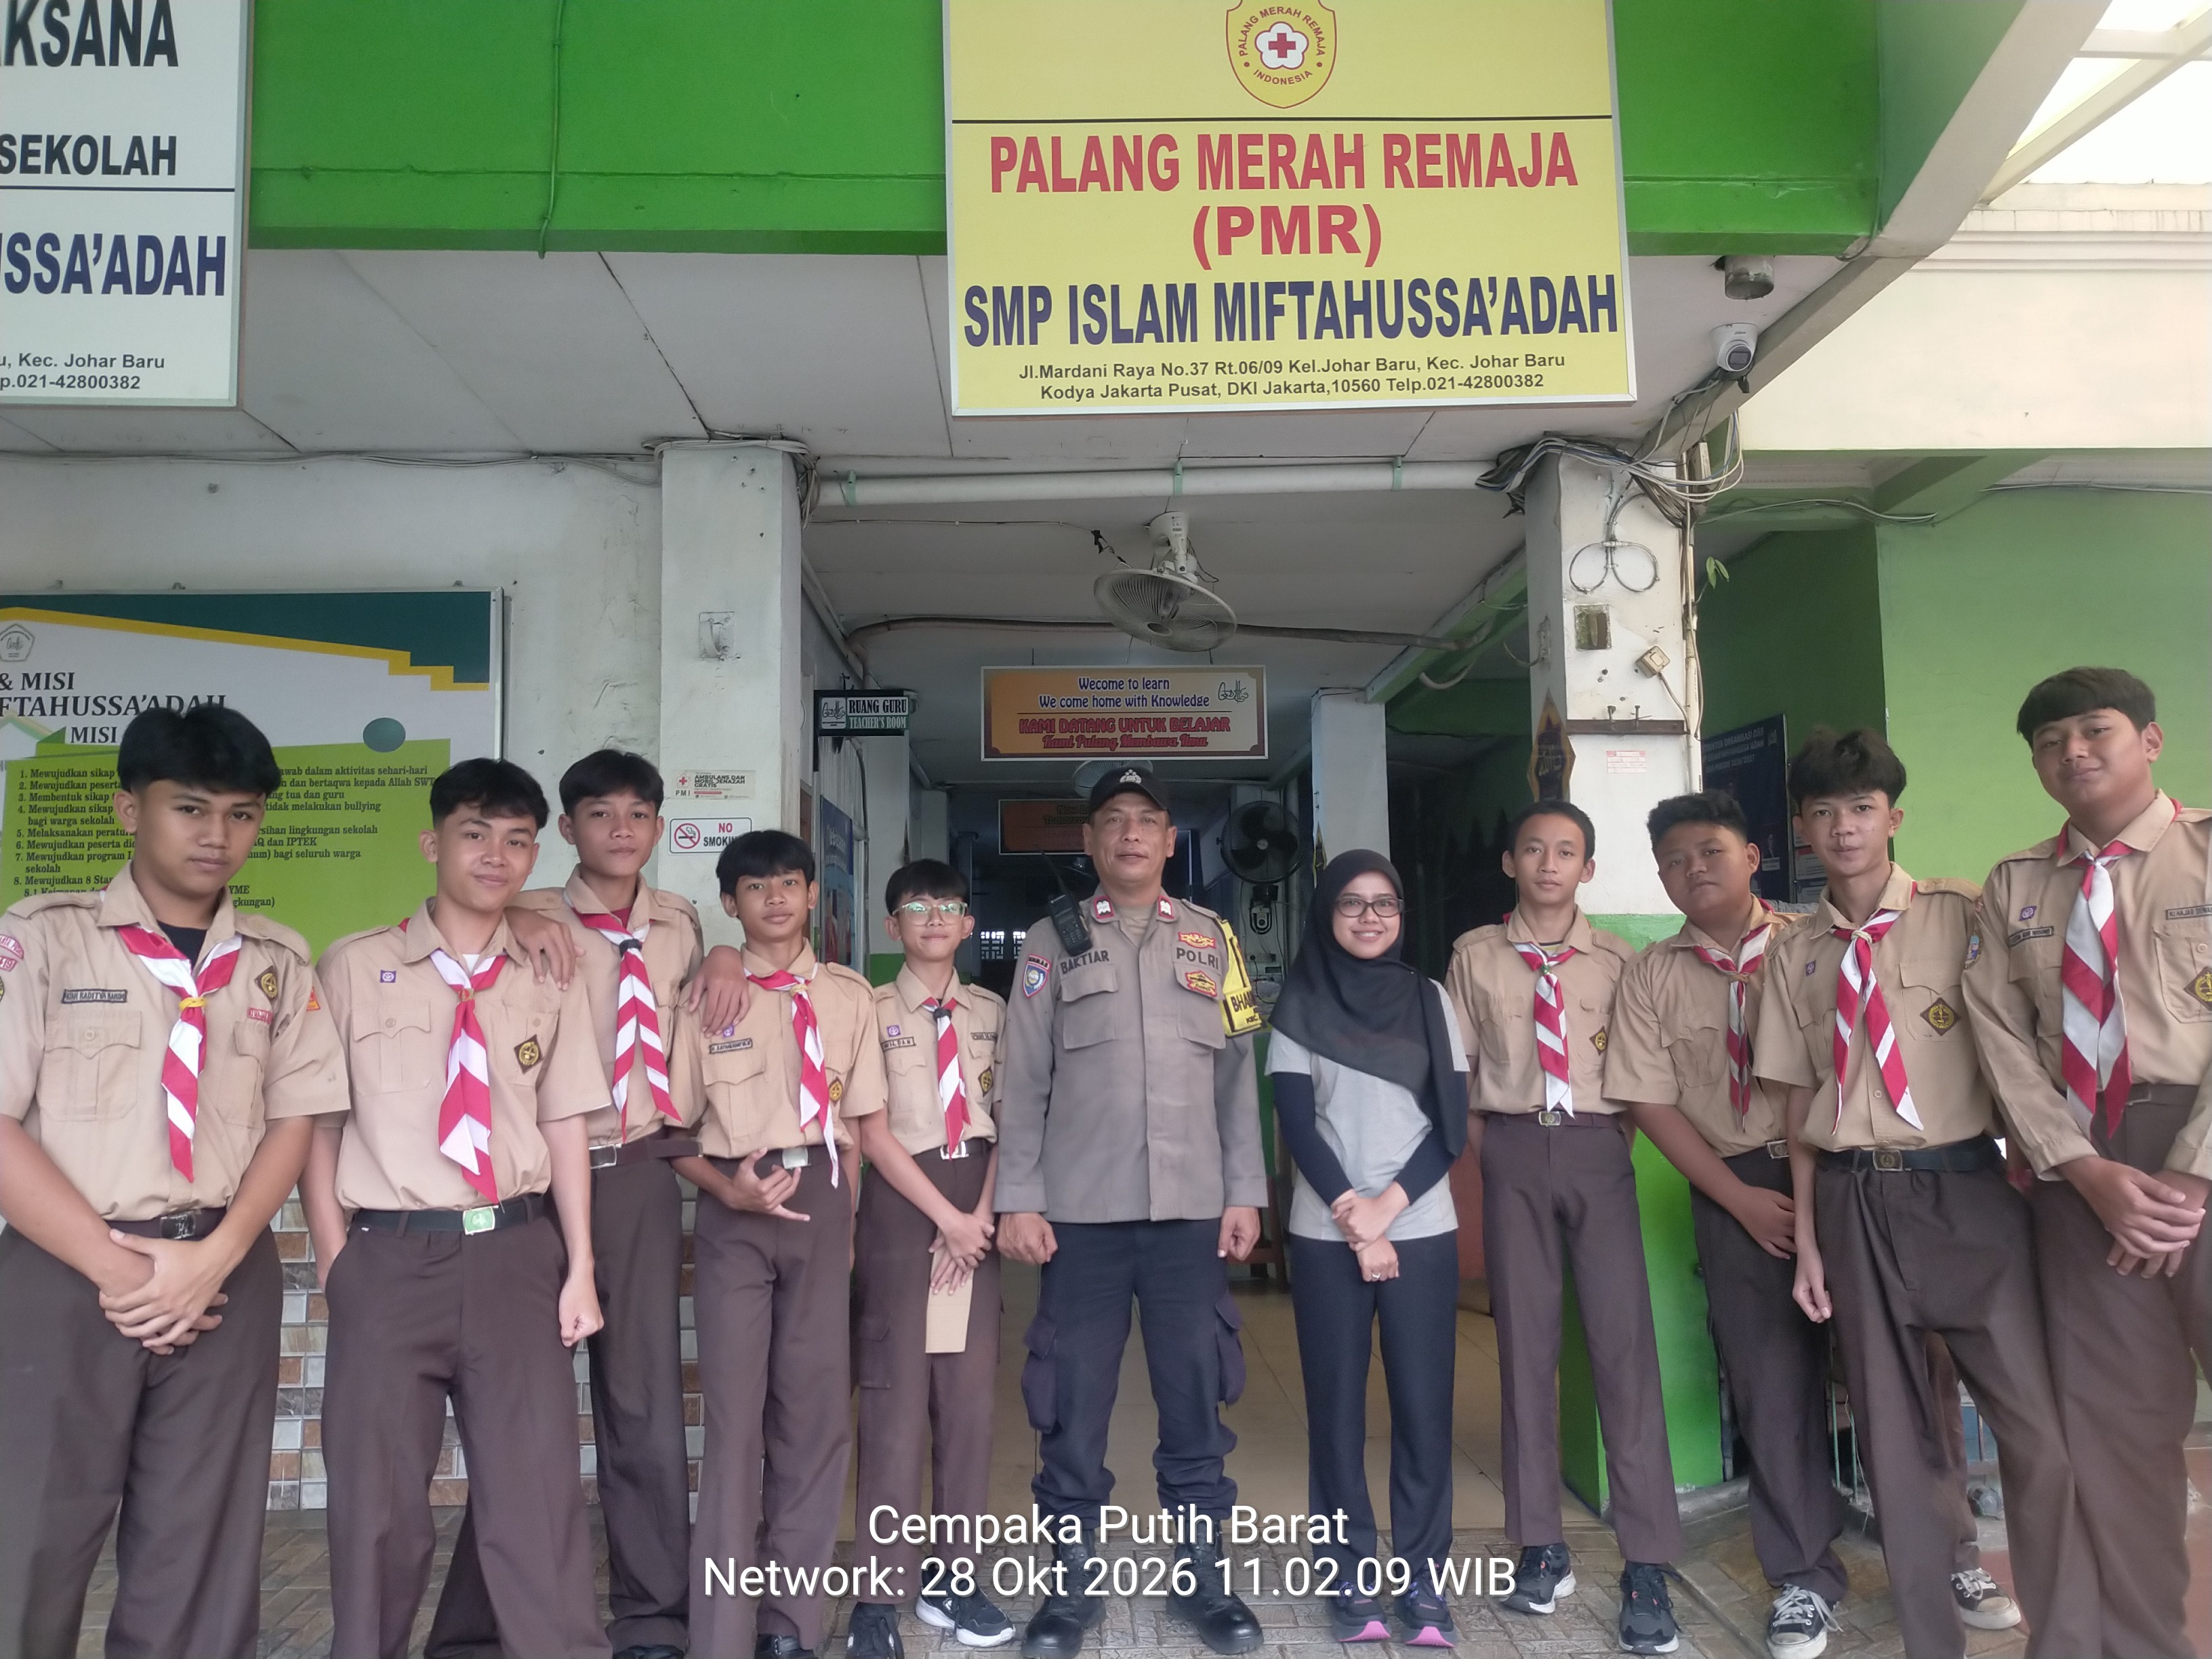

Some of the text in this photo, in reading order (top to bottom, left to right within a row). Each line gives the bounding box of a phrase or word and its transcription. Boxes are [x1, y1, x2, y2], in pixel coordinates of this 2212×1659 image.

[1238, 7, 1326, 56] PALANG MERAH REMAJA
[1253, 69, 1313, 85] INDONESIA
[0, 134, 177, 176] SEKOLAH
[991, 132, 1578, 192] PALANG MERAH REMAJA
[1193, 204, 1381, 270] (PMR)
[0, 232, 226, 295] SSA'ADAH
[964, 274, 1618, 347] SMP ISLAM MIFTAHUSSA'ADAH
[18, 353, 58, 367] Kec.
[64, 354, 117, 367] Johar
[123, 354, 165, 368] Baru
[1019, 354, 1565, 380] Jl.Mardani Raya No.37 Rt.06/09 Kel.Johar Baru, Kec. Johar Baru
[1041, 374, 1544, 403] Kodya Jakarta Pusat, DKI Jakarta,10560 Telp.021-42800382
[20, 672, 75, 690] MISI
[1078, 677, 1170, 691] Wecome to learn
[849, 699, 907, 714] RUANG GURU
[1039, 694, 1210, 708] We come home with Knowledge
[849, 716, 884, 729] TEACHER'S
[886, 716, 906, 728] ROOM
[1019, 716, 1231, 734] KAMI DATANG UNTUK BELAJAR
[70, 726, 117, 743] MISI
[1076, 735, 1118, 751] Pulang
[30, 769, 87, 779] Mewujudkan
[90, 769, 115, 779] sikap
[305, 766, 332, 775] dalam
[335, 766, 375, 775] aktivitas
[377, 766, 428, 775] sehari-hari
[30, 781, 87, 792] Mewujudkan
[289, 779, 306, 787] dan
[309, 778, 351, 789] bertaqwa
[354, 778, 386, 789] kepada
[388, 777, 411, 786] Allah
[18, 794, 26, 802] 3.
[29, 792, 82, 802] Membentuk
[85, 792, 109, 803] sikap
[286, 790, 301, 799] tua
[304, 790, 320, 799] dan
[323, 792, 344, 801] guru
[28, 804, 86, 815] Mewujudkan
[89, 804, 113, 815] sikap
[266, 802, 289, 811] tidak
[291, 802, 342, 811] melakukan
[344, 802, 382, 812] bullying
[28, 816, 115, 827] bagi warga sekolah
[718, 823, 733, 833] NO
[27, 829, 93, 838] Melaksanakan
[289, 825, 340, 836] lingkungan
[343, 825, 377, 834] sekolah
[26, 840, 85, 851] Mewujudkan
[87, 840, 121, 852] peserta
[267, 837, 284, 846] dan
[287, 837, 317, 846] IPTEK
[703, 836, 739, 846] SMOKI
[26, 852, 84, 863] Mewujudkan
[87, 853, 125, 863] program
[274, 849, 293, 860] bagi
[295, 848, 330, 858] seluruh
[333, 851, 361, 860] warga
[25, 864, 61, 873] sekolah
[14, 877, 22, 885] 8.
[25, 876, 83, 886] Mewujudkan
[85, 876, 91, 884] 8
[1060, 949, 1110, 975] BAKTIAR
[1176, 947, 1218, 970] POLRI
